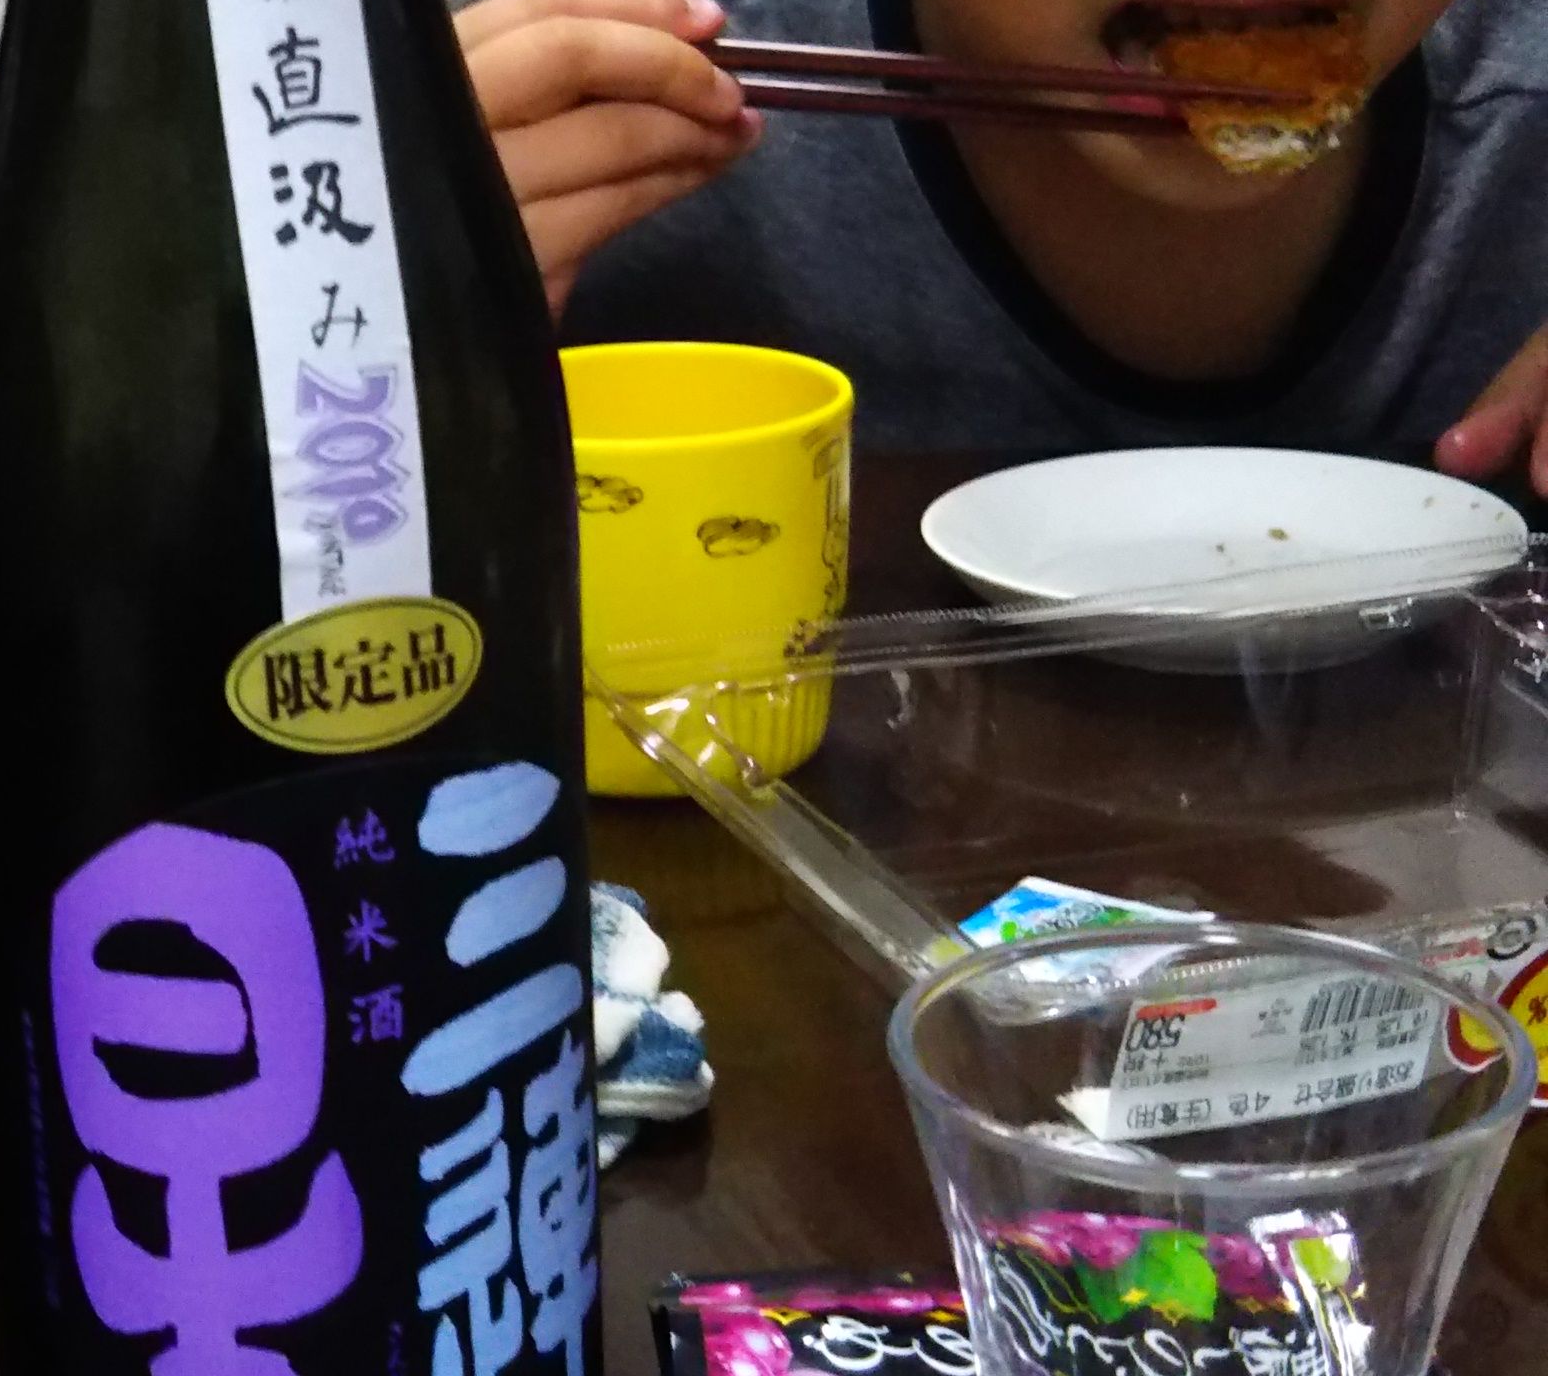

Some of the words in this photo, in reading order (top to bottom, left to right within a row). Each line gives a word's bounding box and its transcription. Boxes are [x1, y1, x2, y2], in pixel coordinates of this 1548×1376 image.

[252, 25, 376, 350] 直汲み
[261, 621, 459, 722] 限定品
[331, 807, 405, 1046] 純米酒
